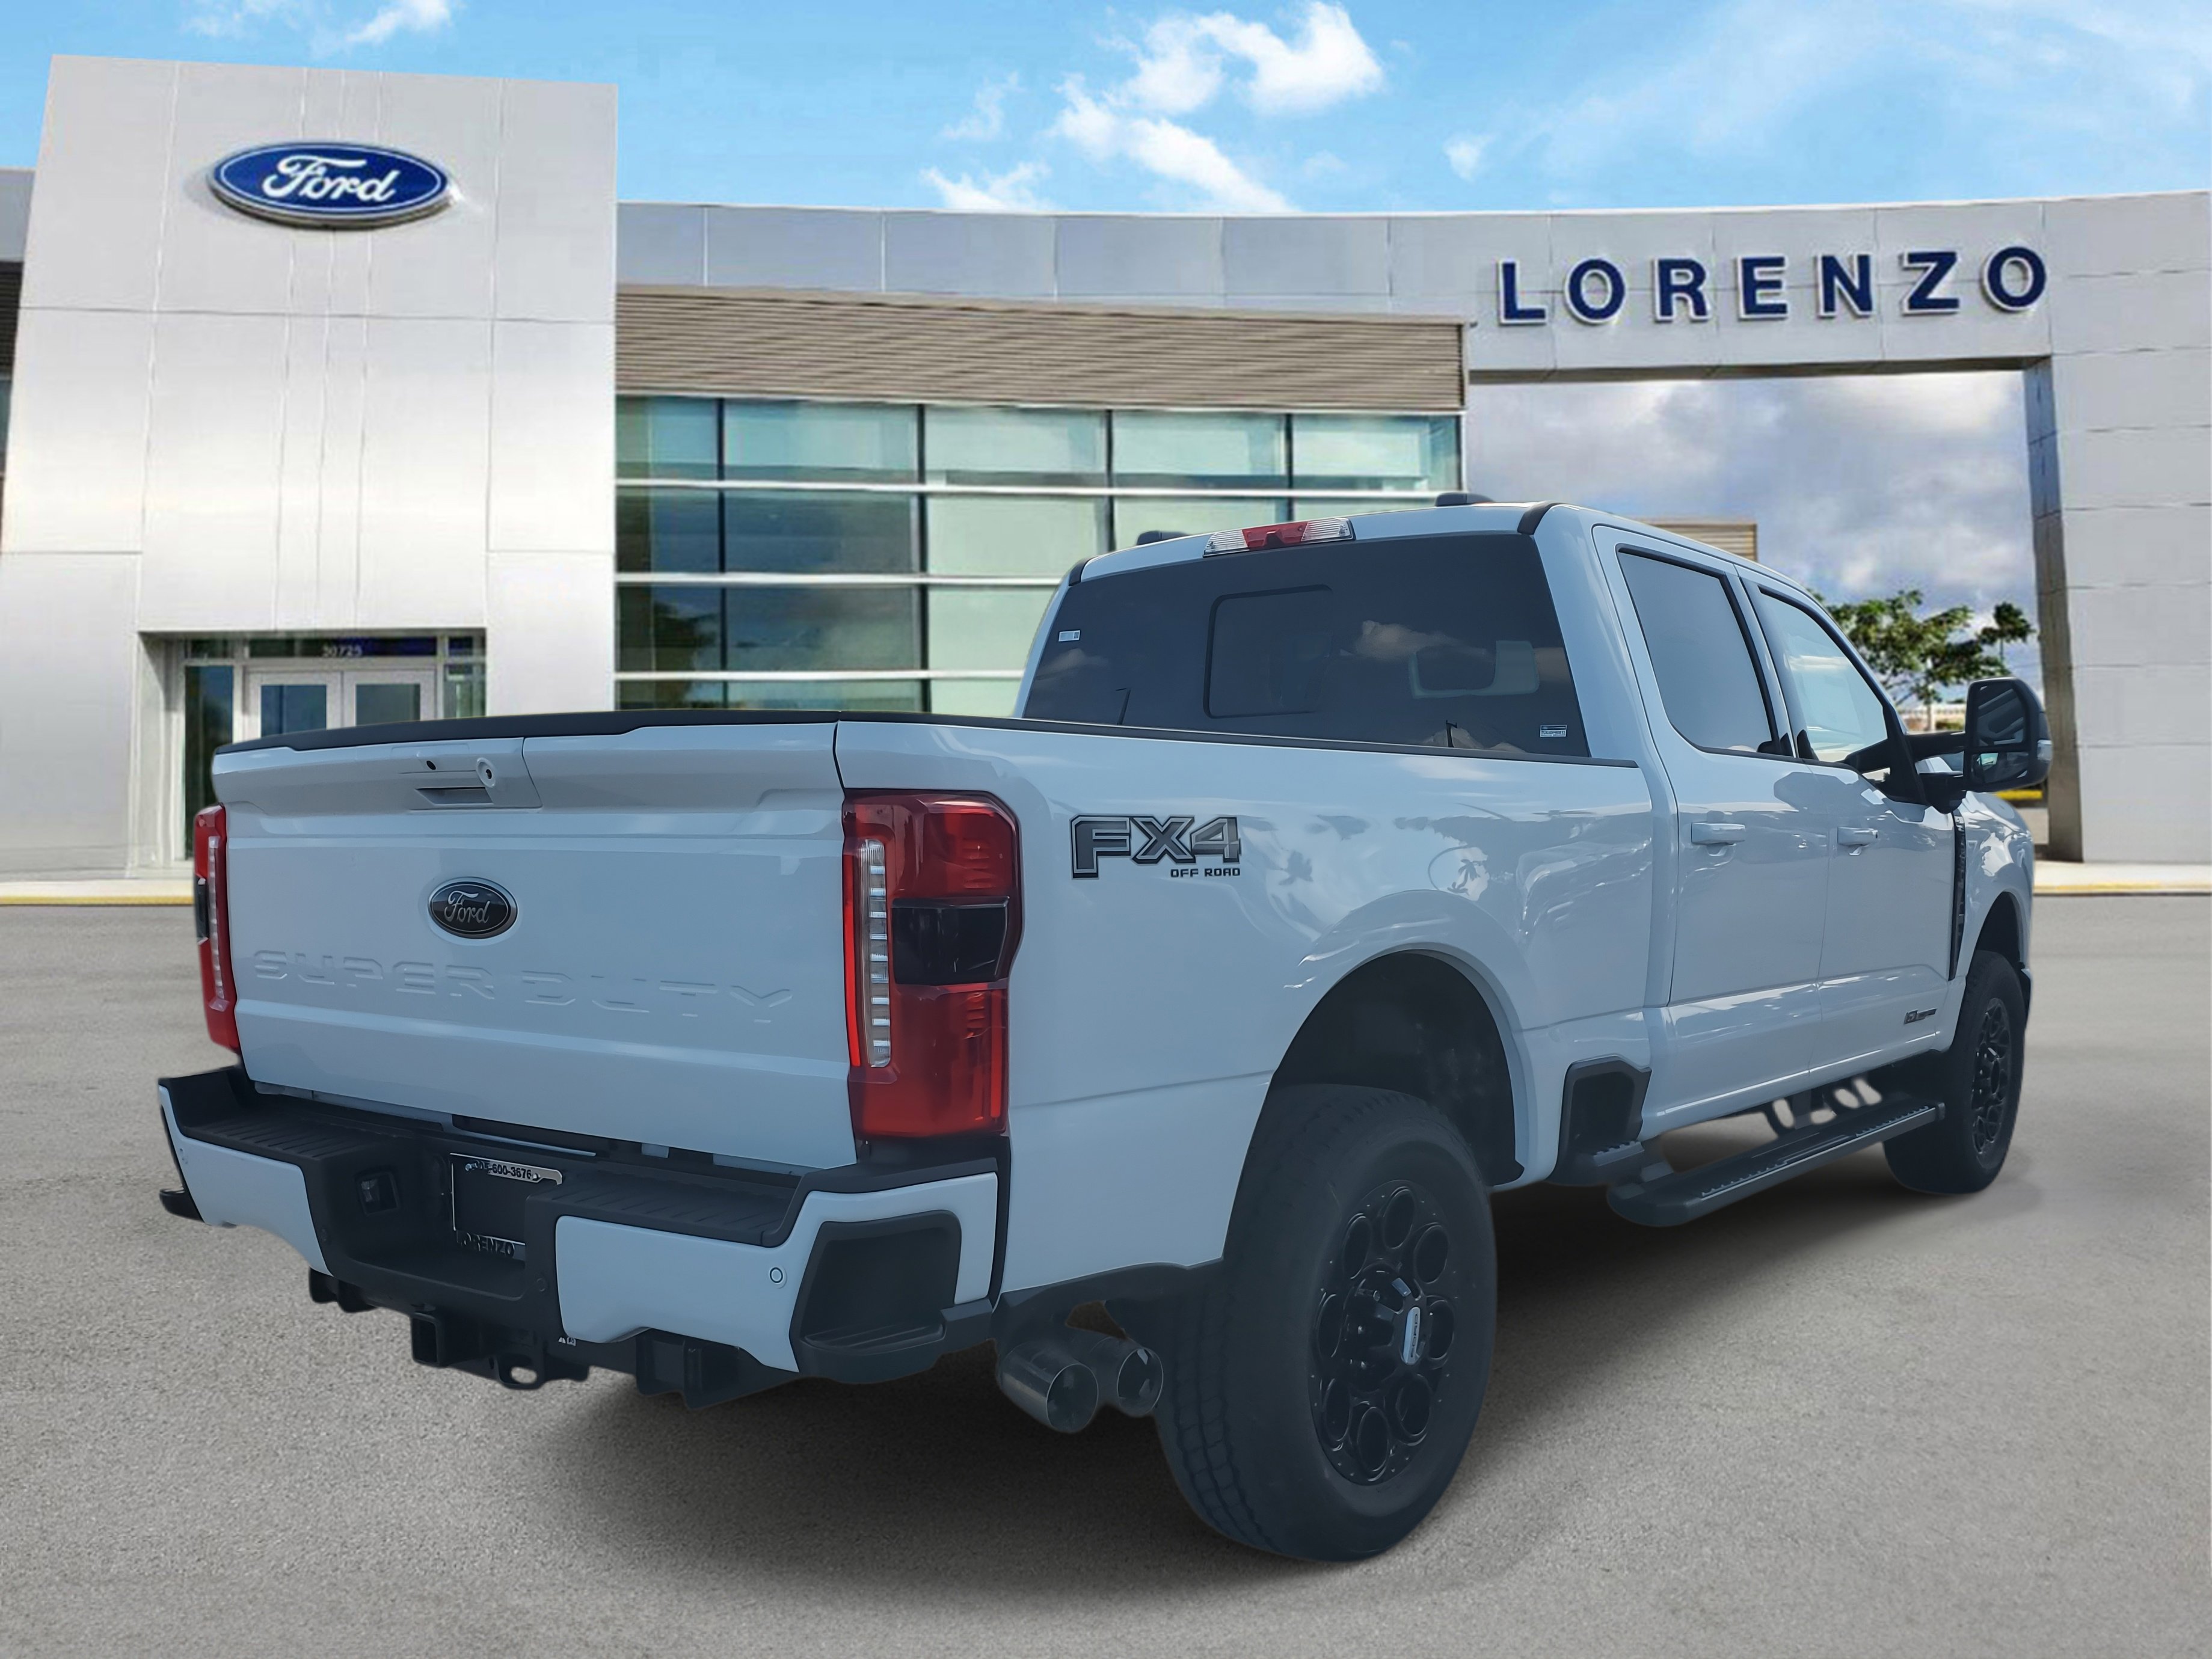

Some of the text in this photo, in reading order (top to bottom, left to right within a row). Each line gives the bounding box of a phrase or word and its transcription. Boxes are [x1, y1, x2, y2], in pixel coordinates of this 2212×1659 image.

[262, 154, 401, 202] Ford
[1498, 247, 2047, 325] LORENZO
[1070, 814, 1242, 880] FX4
[1170, 868, 1241, 878] OFF ROAD
[444, 890, 491, 924] Ford
[254, 950, 793, 1023] SUPER DUTY
